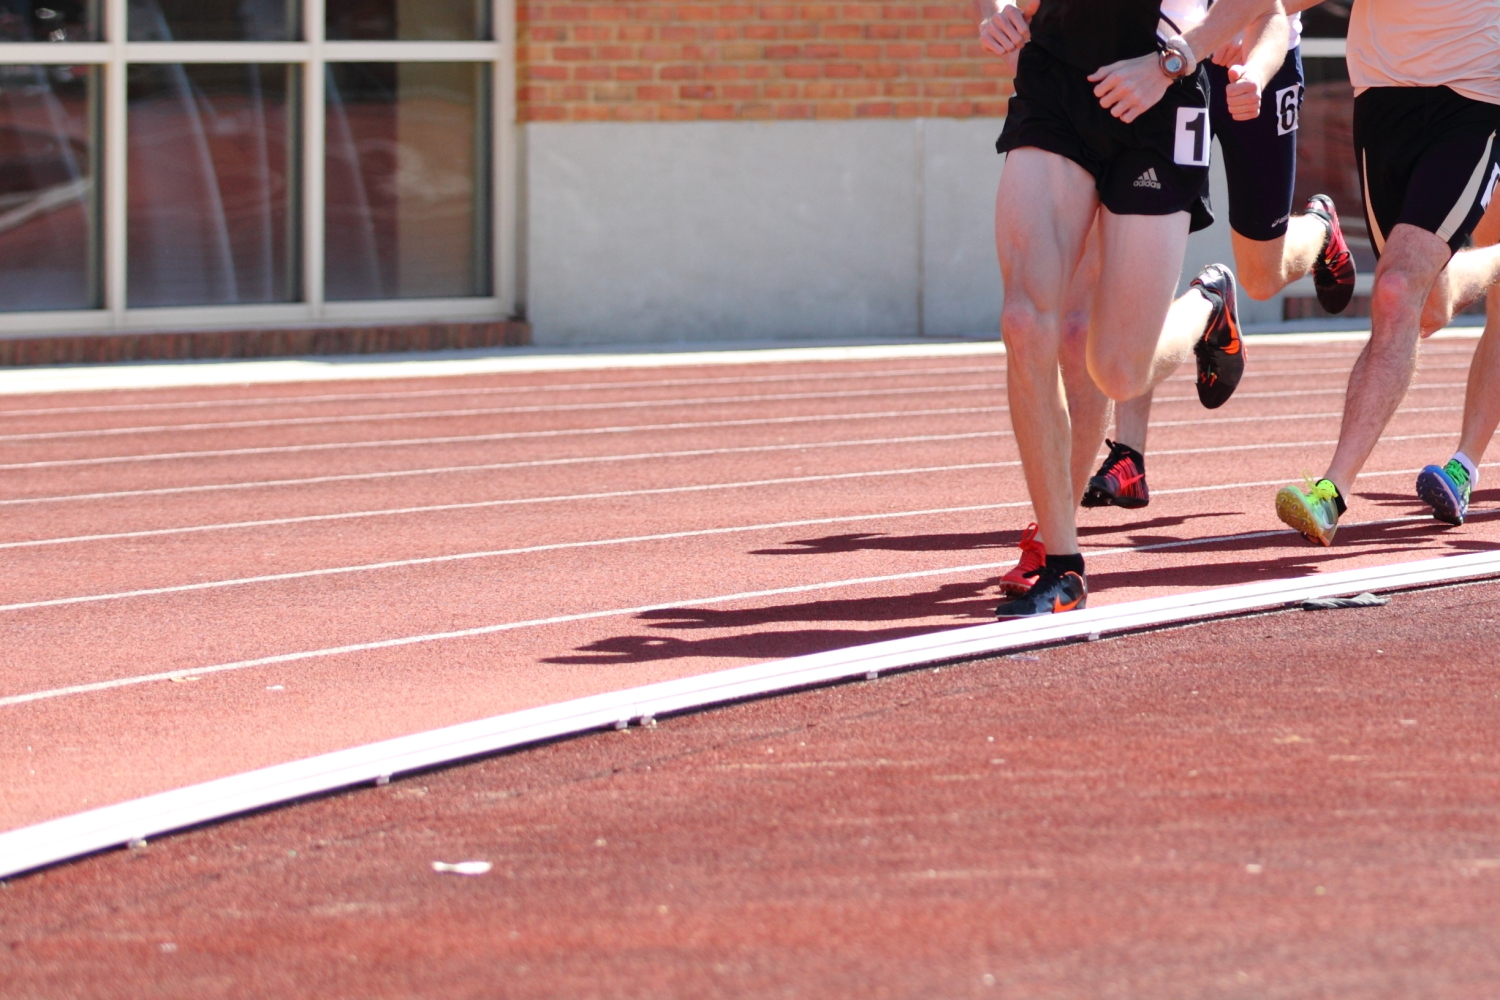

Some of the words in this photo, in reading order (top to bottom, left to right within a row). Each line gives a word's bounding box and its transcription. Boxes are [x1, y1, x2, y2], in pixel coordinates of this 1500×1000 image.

[1279, 90, 1297, 131] 6
[1185, 112, 1207, 162] 1
[1133, 179, 1162, 190] adidas
